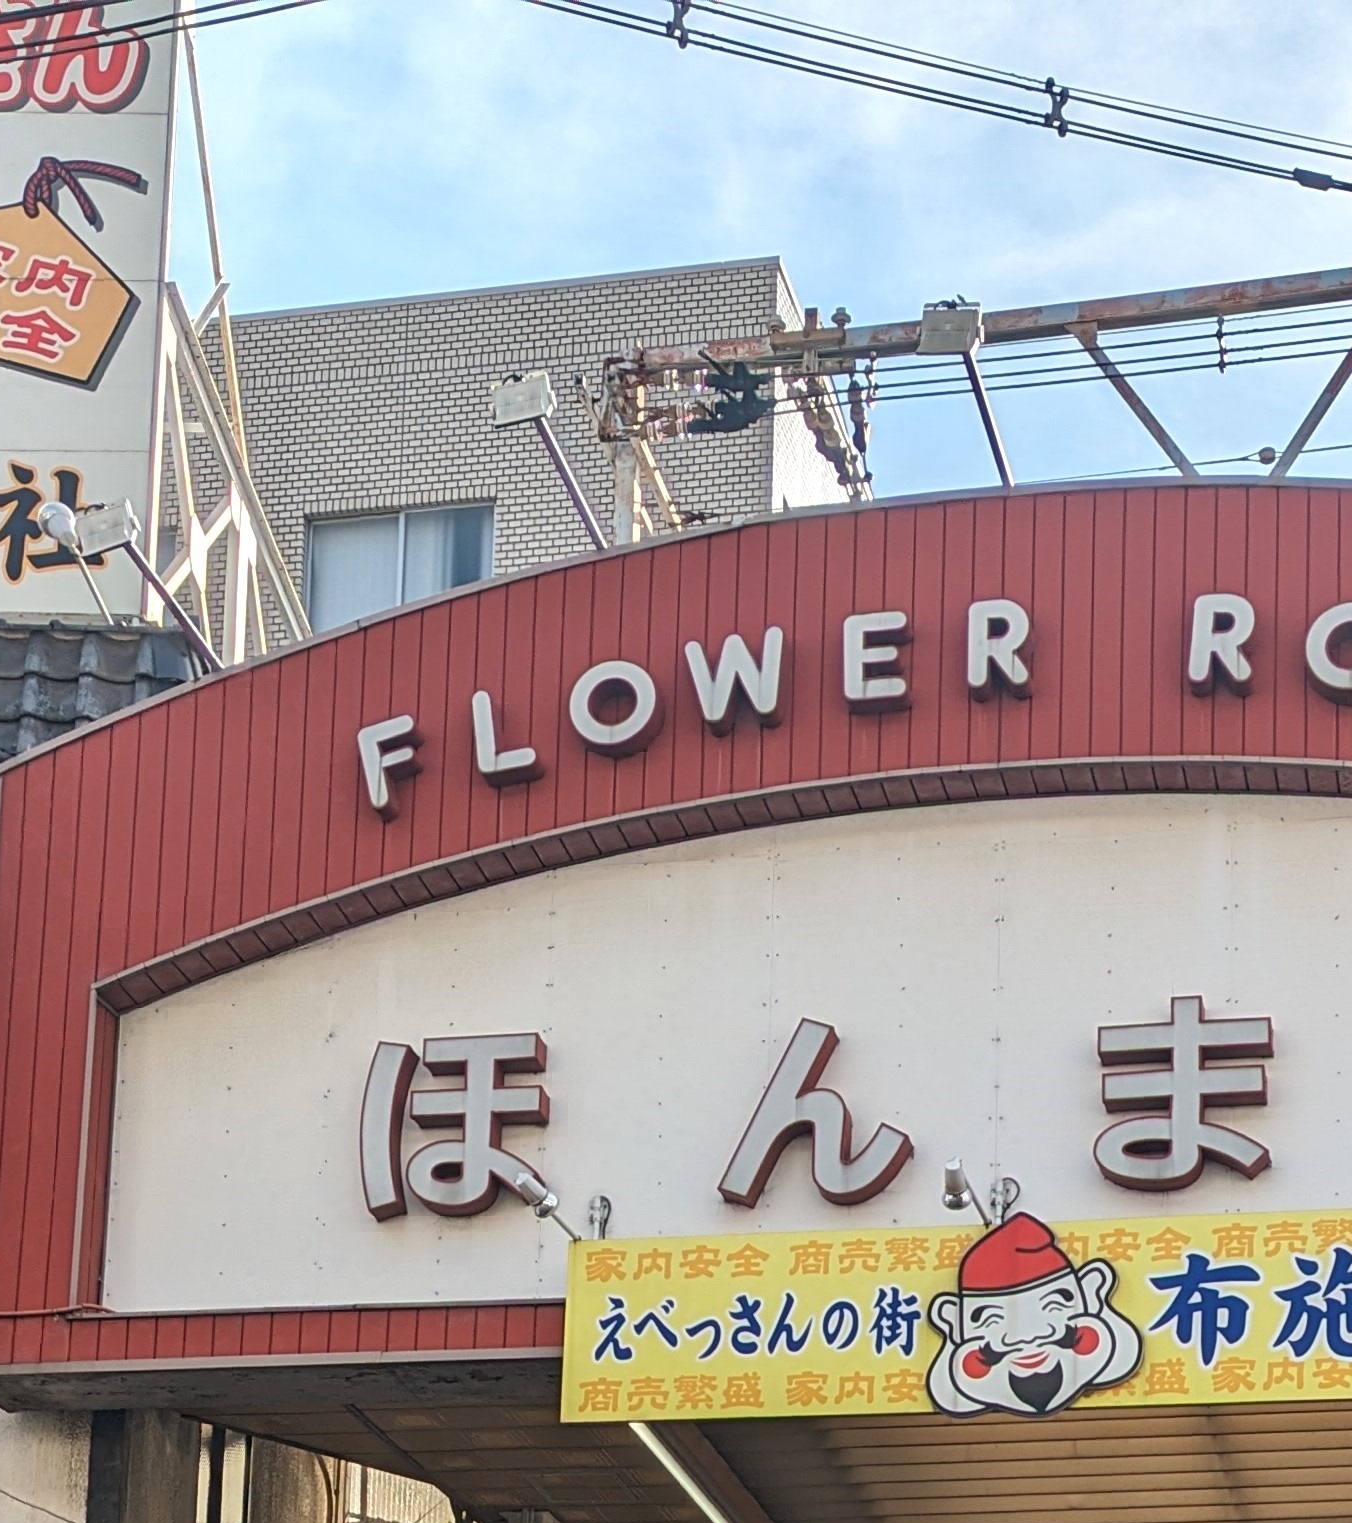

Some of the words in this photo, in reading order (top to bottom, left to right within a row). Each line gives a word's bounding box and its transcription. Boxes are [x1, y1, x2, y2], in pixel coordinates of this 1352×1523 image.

[355, 598, 1034, 816] FLOWER
[584, 1242, 770, 1283] 家内安全
[788, 1233, 974, 1276] 商売繁盛
[593, 1286, 922, 1362] えべっさんの街
[578, 1371, 765, 1412] 商売繁盛
